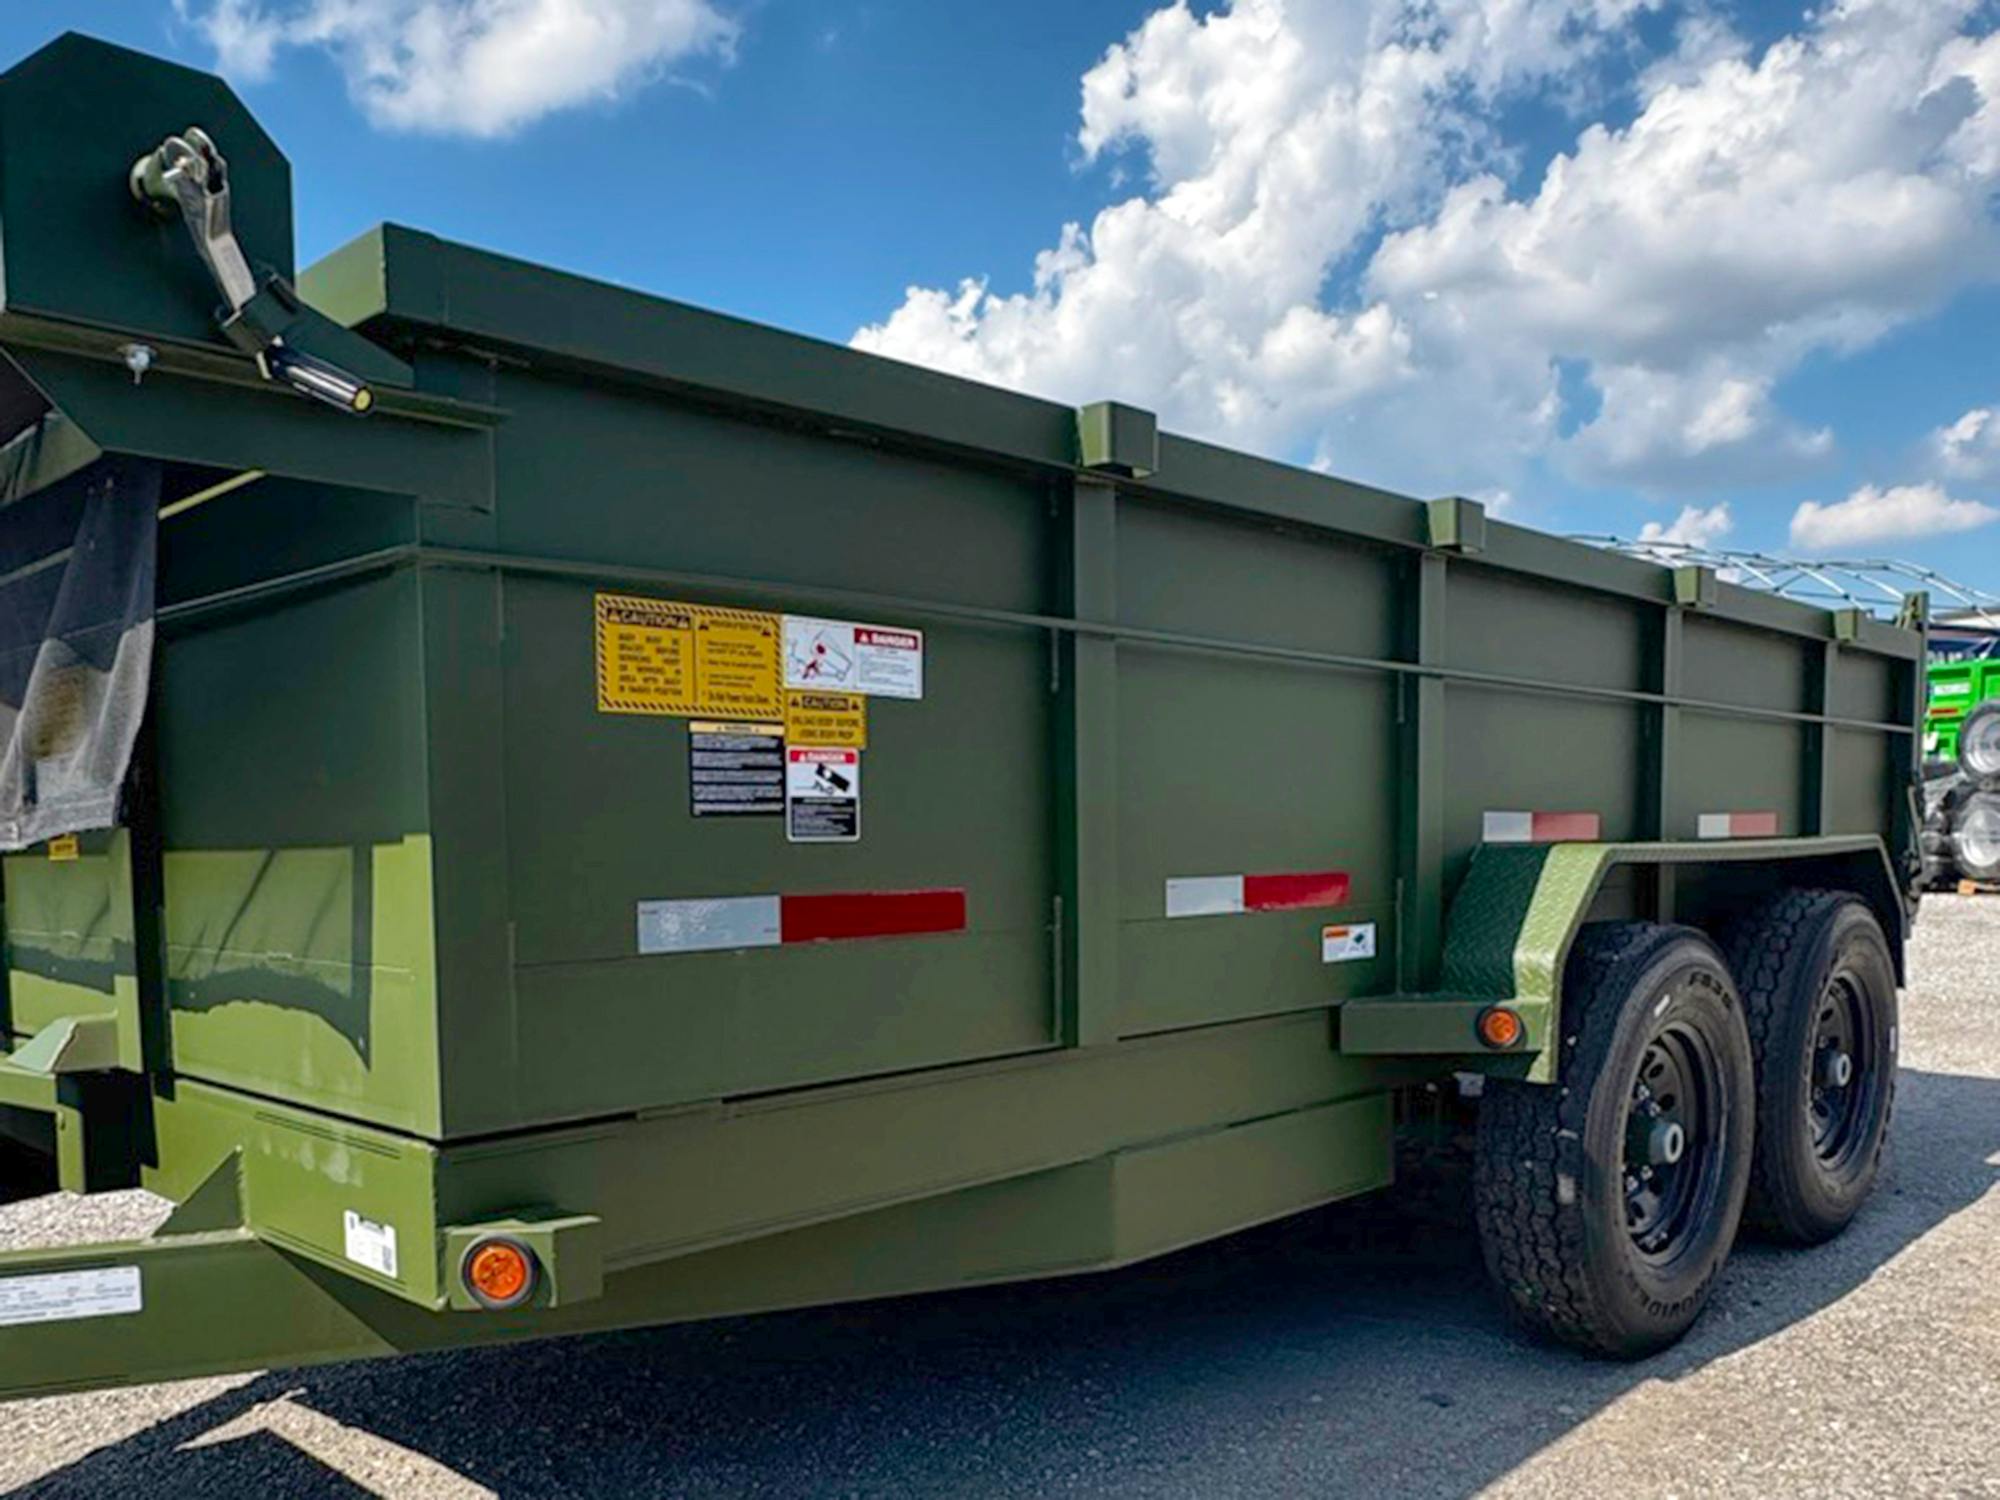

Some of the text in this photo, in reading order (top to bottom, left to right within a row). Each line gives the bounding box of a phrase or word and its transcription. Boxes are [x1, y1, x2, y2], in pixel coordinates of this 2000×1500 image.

[621, 610, 676, 628] CAUTION
[871, 631, 916, 648] DANGER
[803, 696, 847, 711] CAUTION
[805, 751, 846, 763] DANGER
